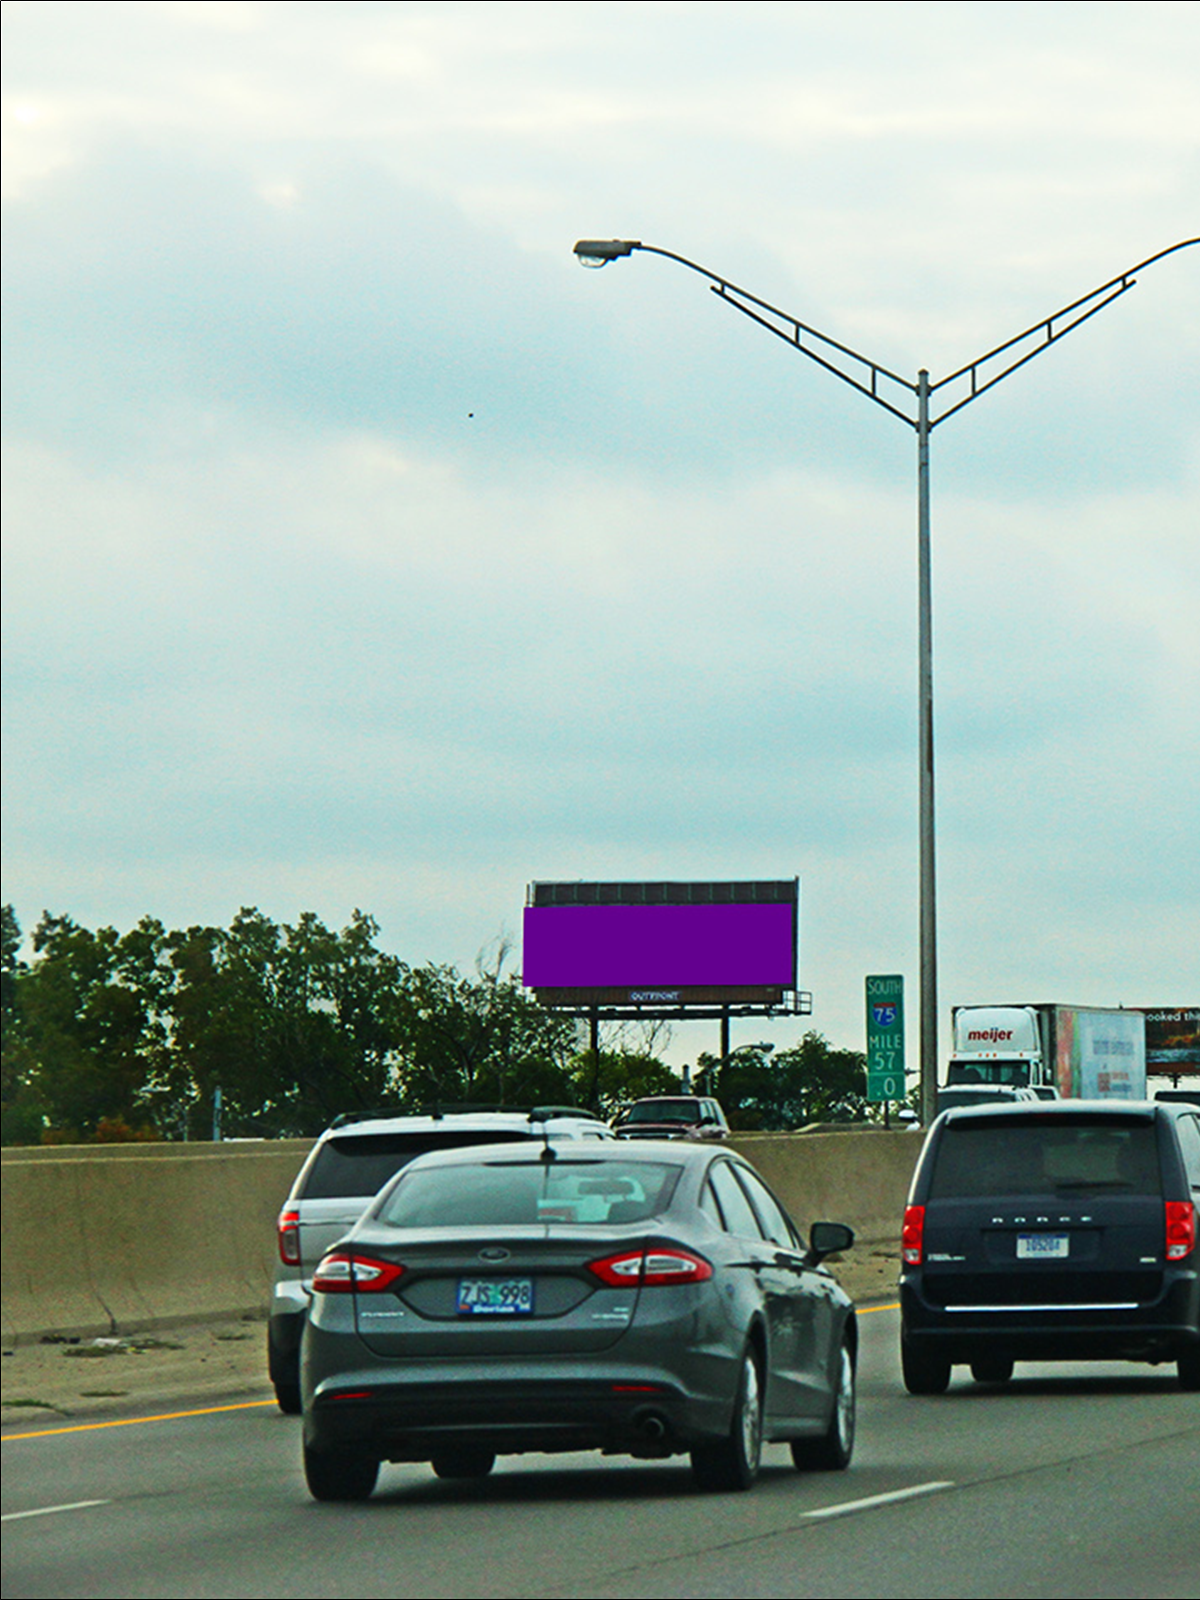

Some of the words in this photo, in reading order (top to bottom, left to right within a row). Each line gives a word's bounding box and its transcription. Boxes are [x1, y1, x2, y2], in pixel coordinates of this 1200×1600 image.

[867, 979, 902, 995] SOUTH
[874, 1007, 895, 1022] 75
[1145, 1010, 1181, 1022] ooked
[869, 1034, 901, 1049] MILE
[968, 1027, 1013, 1043] meijer
[875, 1051, 895, 1070] 57
[499, 1284, 530, 1304] 998
